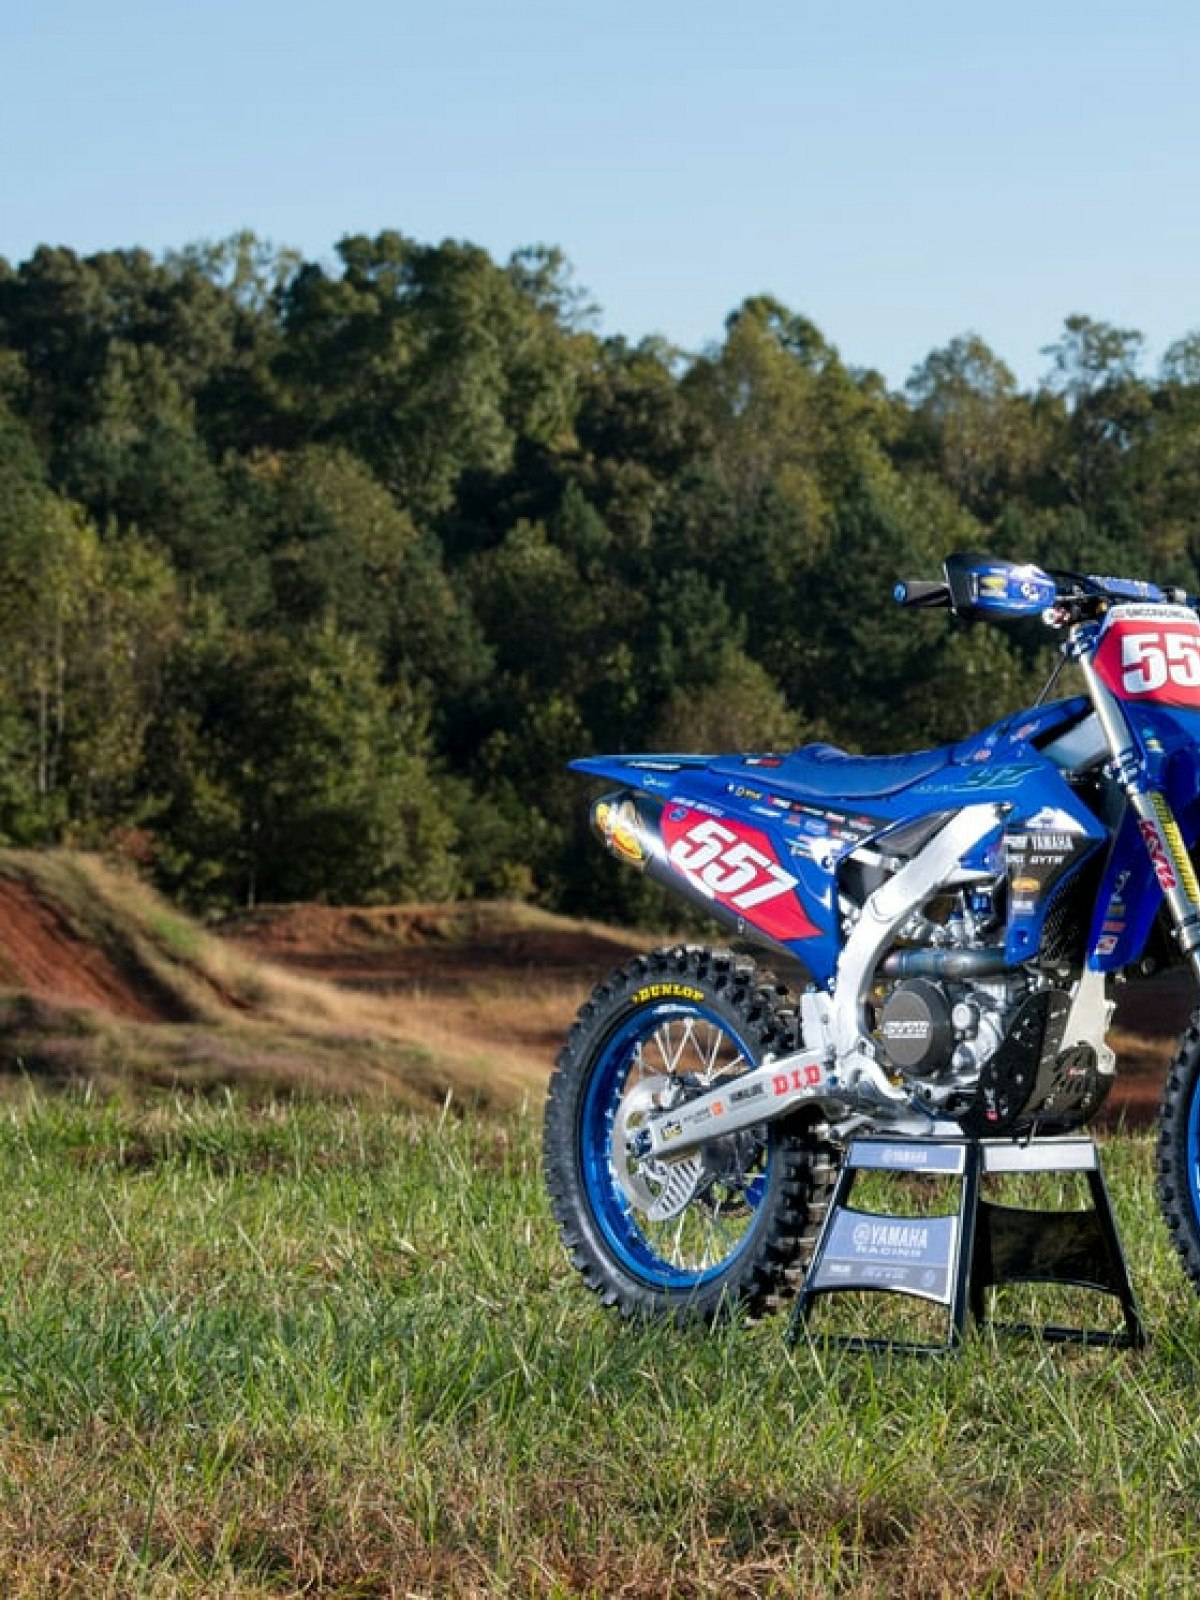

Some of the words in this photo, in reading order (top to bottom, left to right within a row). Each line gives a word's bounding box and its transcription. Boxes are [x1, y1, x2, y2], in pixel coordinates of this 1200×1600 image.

[668, 819, 800, 910] 557
[639, 983, 705, 1003] DUNLOP
[872, 1224, 928, 1249] YAMAHA
